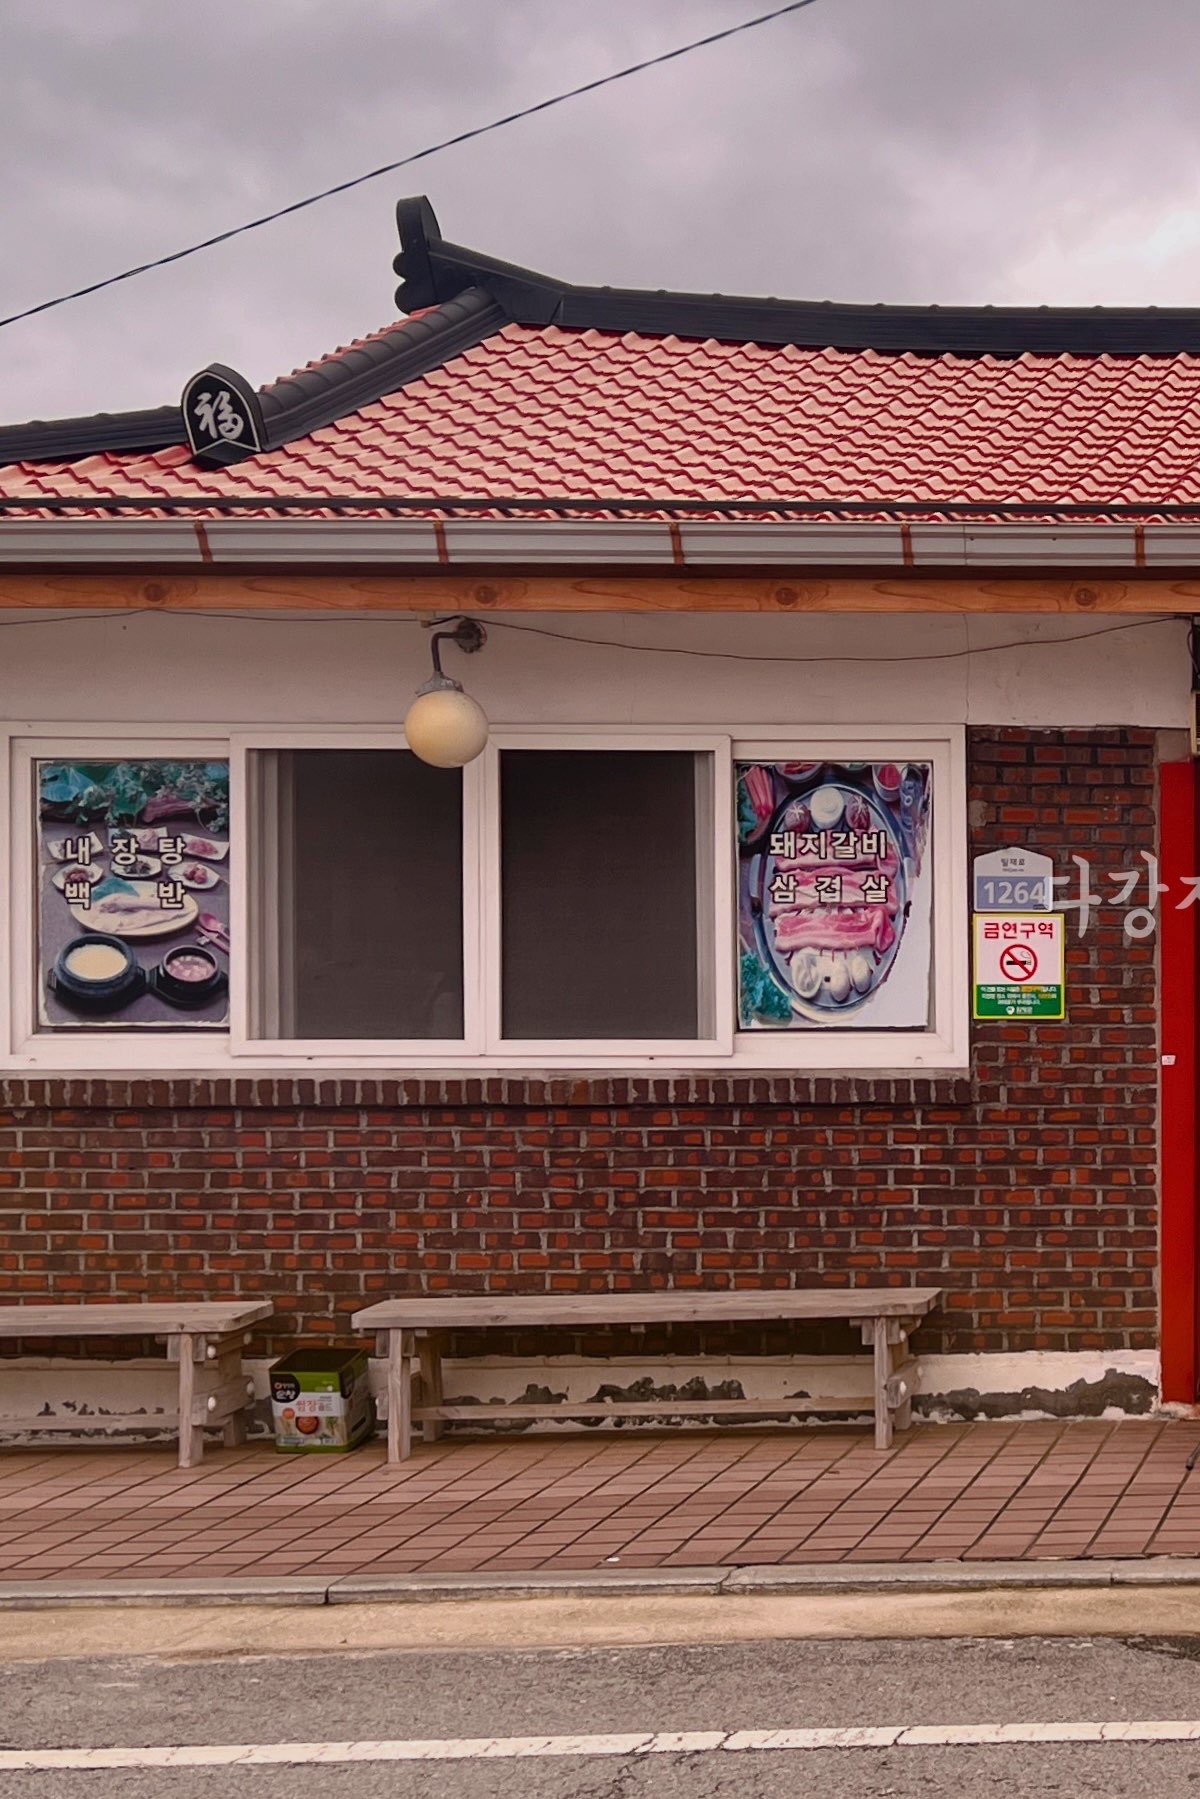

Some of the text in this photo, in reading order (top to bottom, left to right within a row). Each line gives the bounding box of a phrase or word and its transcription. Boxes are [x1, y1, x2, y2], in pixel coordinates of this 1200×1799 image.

[194, 391, 244, 440] 福
[64, 836, 186, 866] 내장탕
[769, 830, 888, 859] 돼지갈비
[64, 880, 186, 910] 백반
[768, 875, 890, 904] 삼겹살
[984, 881, 1045, 904] 1264
[984, 922, 1053, 939] 금연구역
